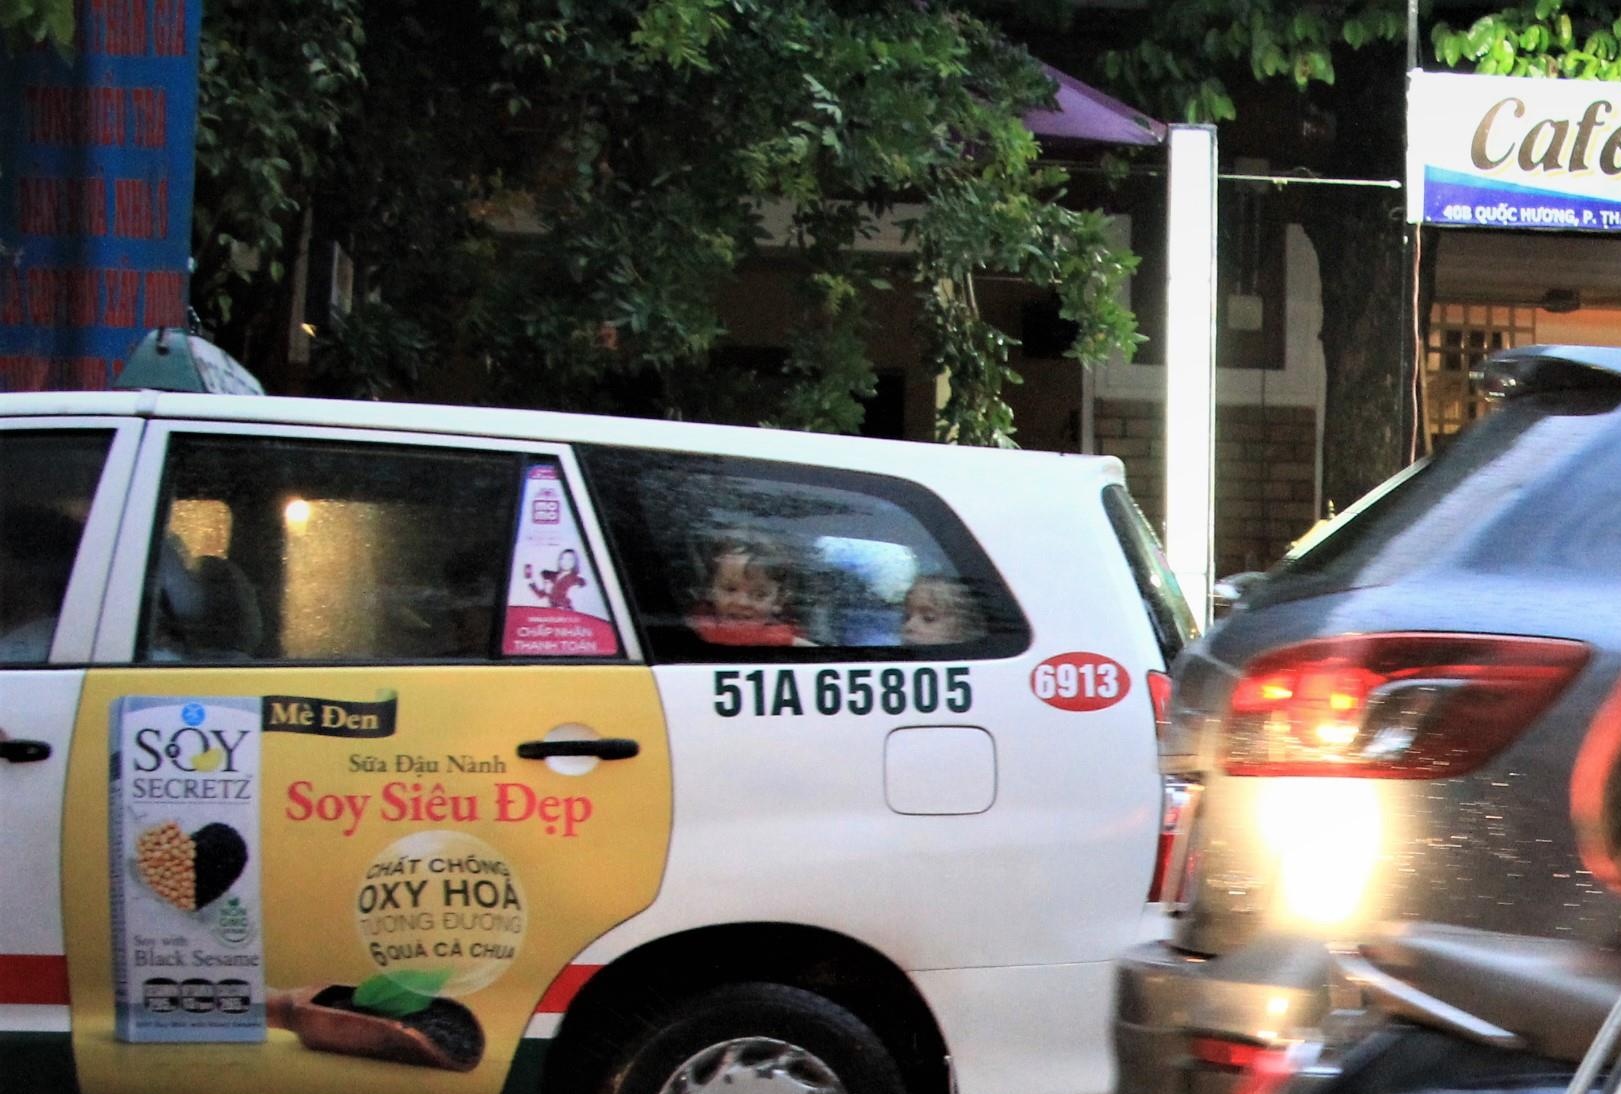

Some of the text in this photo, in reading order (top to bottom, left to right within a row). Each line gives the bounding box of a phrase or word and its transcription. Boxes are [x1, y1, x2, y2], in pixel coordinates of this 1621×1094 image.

[1443, 205, 1473, 220] 40B
[1475, 202, 1517, 225] QUỐC
[1583, 209, 1597, 225] P.
[714, 667, 973, 717] 51A 65805
[1034, 663, 1120, 700] 6913
[270, 702, 380, 730] Mè Đen
[133, 728, 251, 773] SOY
[349, 755, 507, 777] Sữa Đậu Nành
[132, 778, 252, 799] SECRETZ
[285, 781, 593, 837] Soy Siêu Đẹp
[366, 856, 422, 880] CHẤT
[358, 879, 428, 914] OXY
[135, 950, 260, 967] Black Sesame
